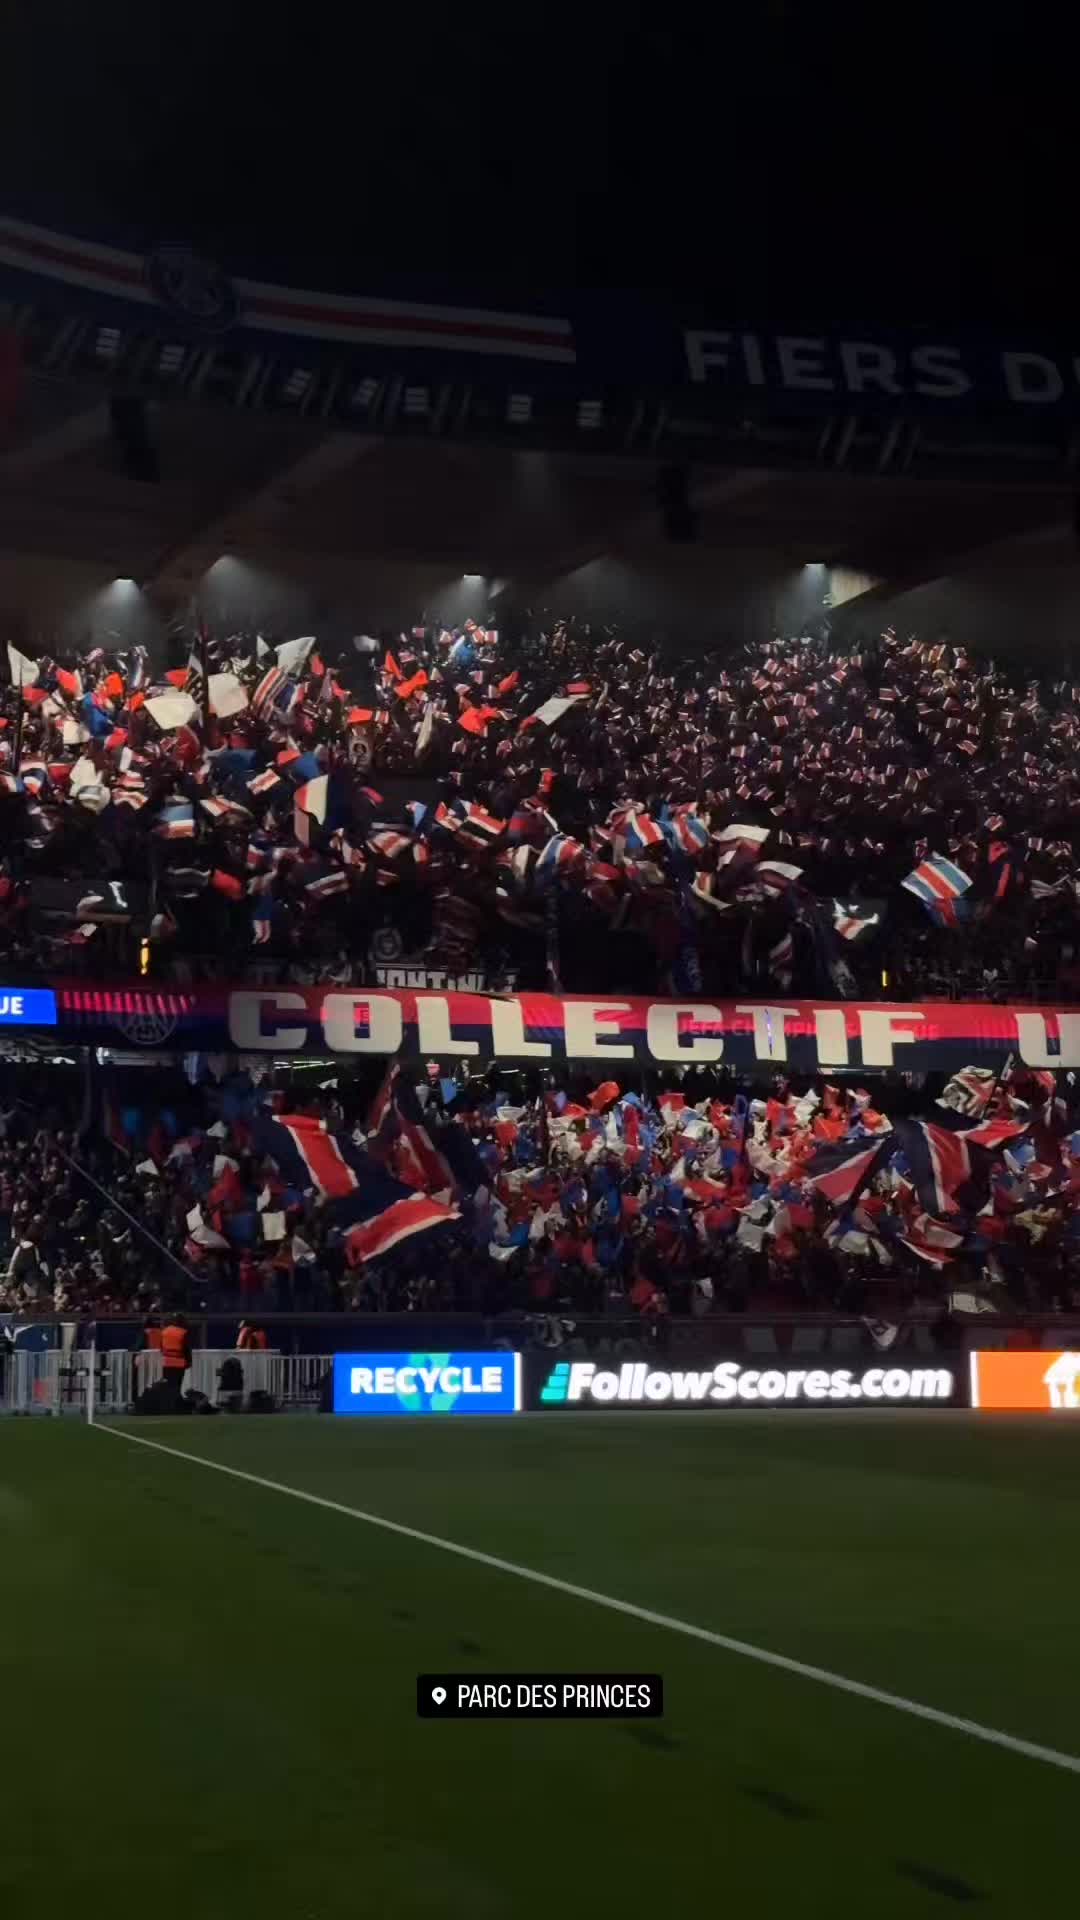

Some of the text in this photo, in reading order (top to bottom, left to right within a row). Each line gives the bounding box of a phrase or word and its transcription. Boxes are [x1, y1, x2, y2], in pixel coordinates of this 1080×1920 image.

[685, 329, 1080, 404] FIERS D
[229, 991, 925, 1066] COLLECTIF
[350, 1366, 504, 1394] RECYCLE
[567, 1361, 953, 1401] FollowScores.com
